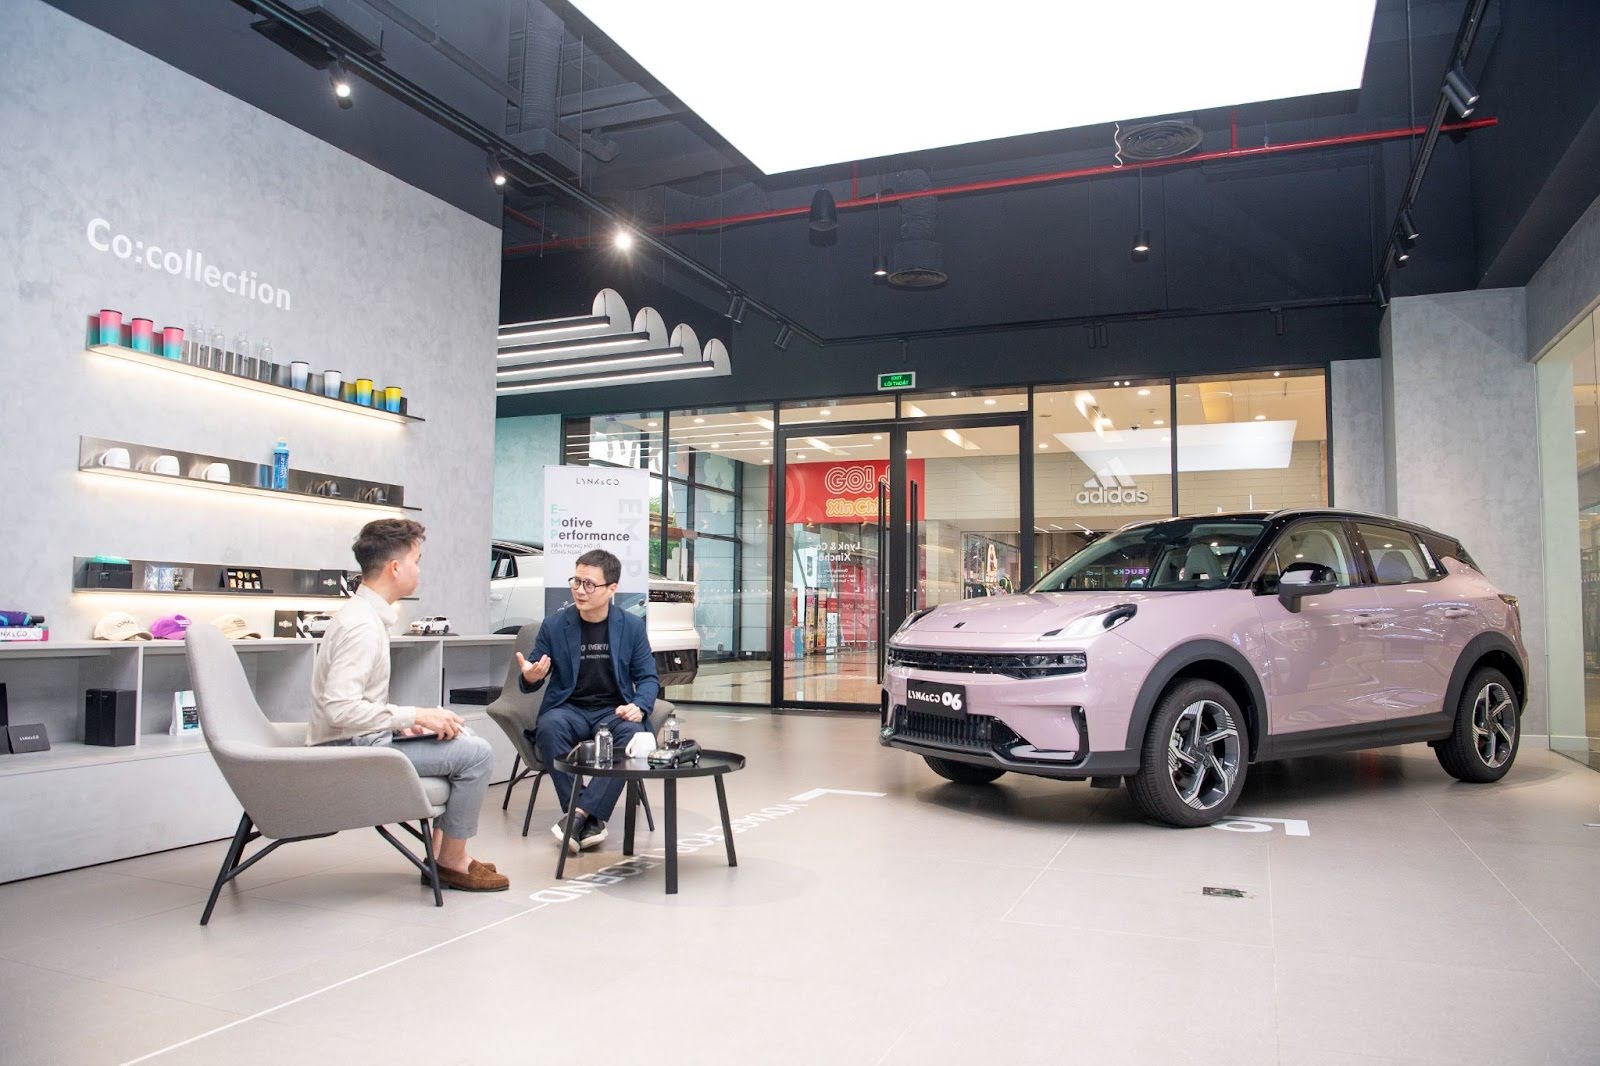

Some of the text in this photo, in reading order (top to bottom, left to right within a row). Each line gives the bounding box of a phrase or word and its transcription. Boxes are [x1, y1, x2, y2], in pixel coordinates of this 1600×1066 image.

[87, 218, 291, 310] Co:collection
[825, 465, 875, 494] GO!
[1075, 486, 1149, 505] adidas
[826, 498, 854, 517] Xin
[550, 529, 630, 541] Performance
[941, 691, 962, 711] 06
